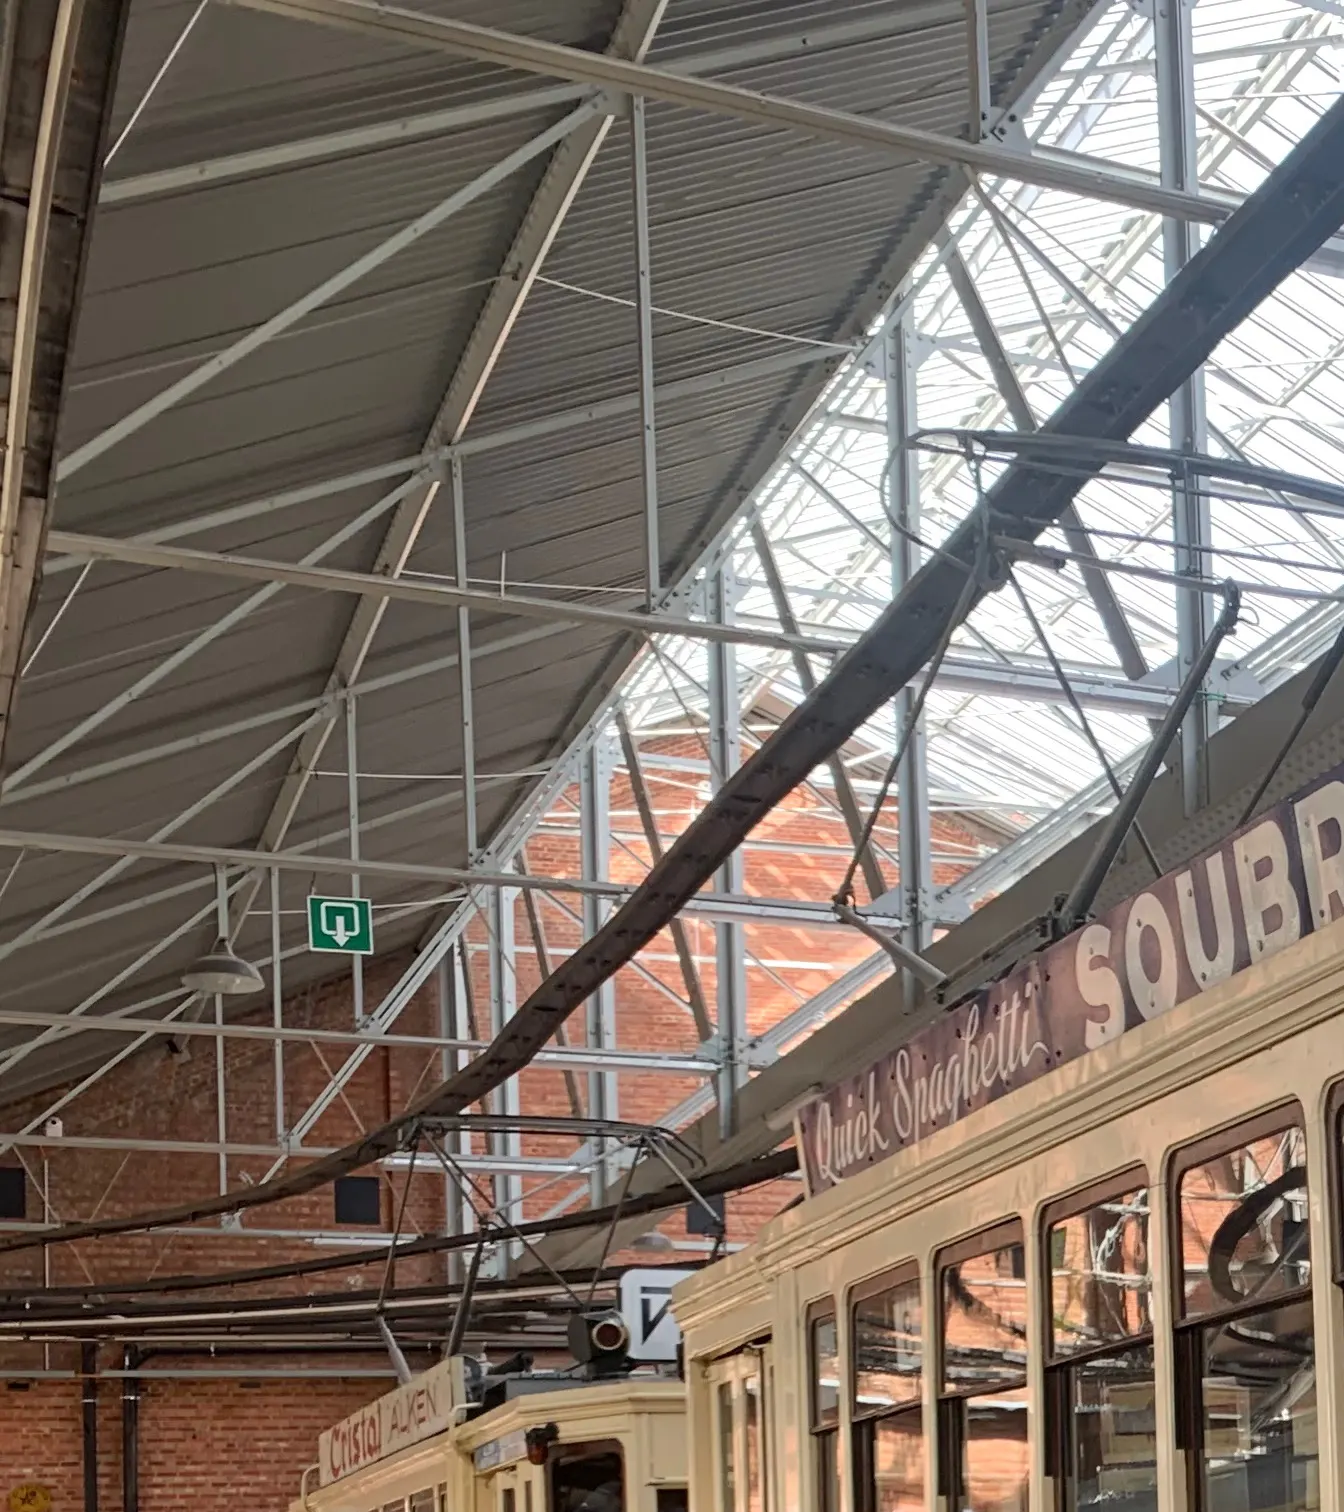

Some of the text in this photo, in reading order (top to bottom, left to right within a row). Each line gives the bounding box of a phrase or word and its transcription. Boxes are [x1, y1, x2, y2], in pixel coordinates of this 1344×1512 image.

[815, 982, 1049, 1184] Quick Spaghetti
[329, 1401, 383, 1479] Cristal
